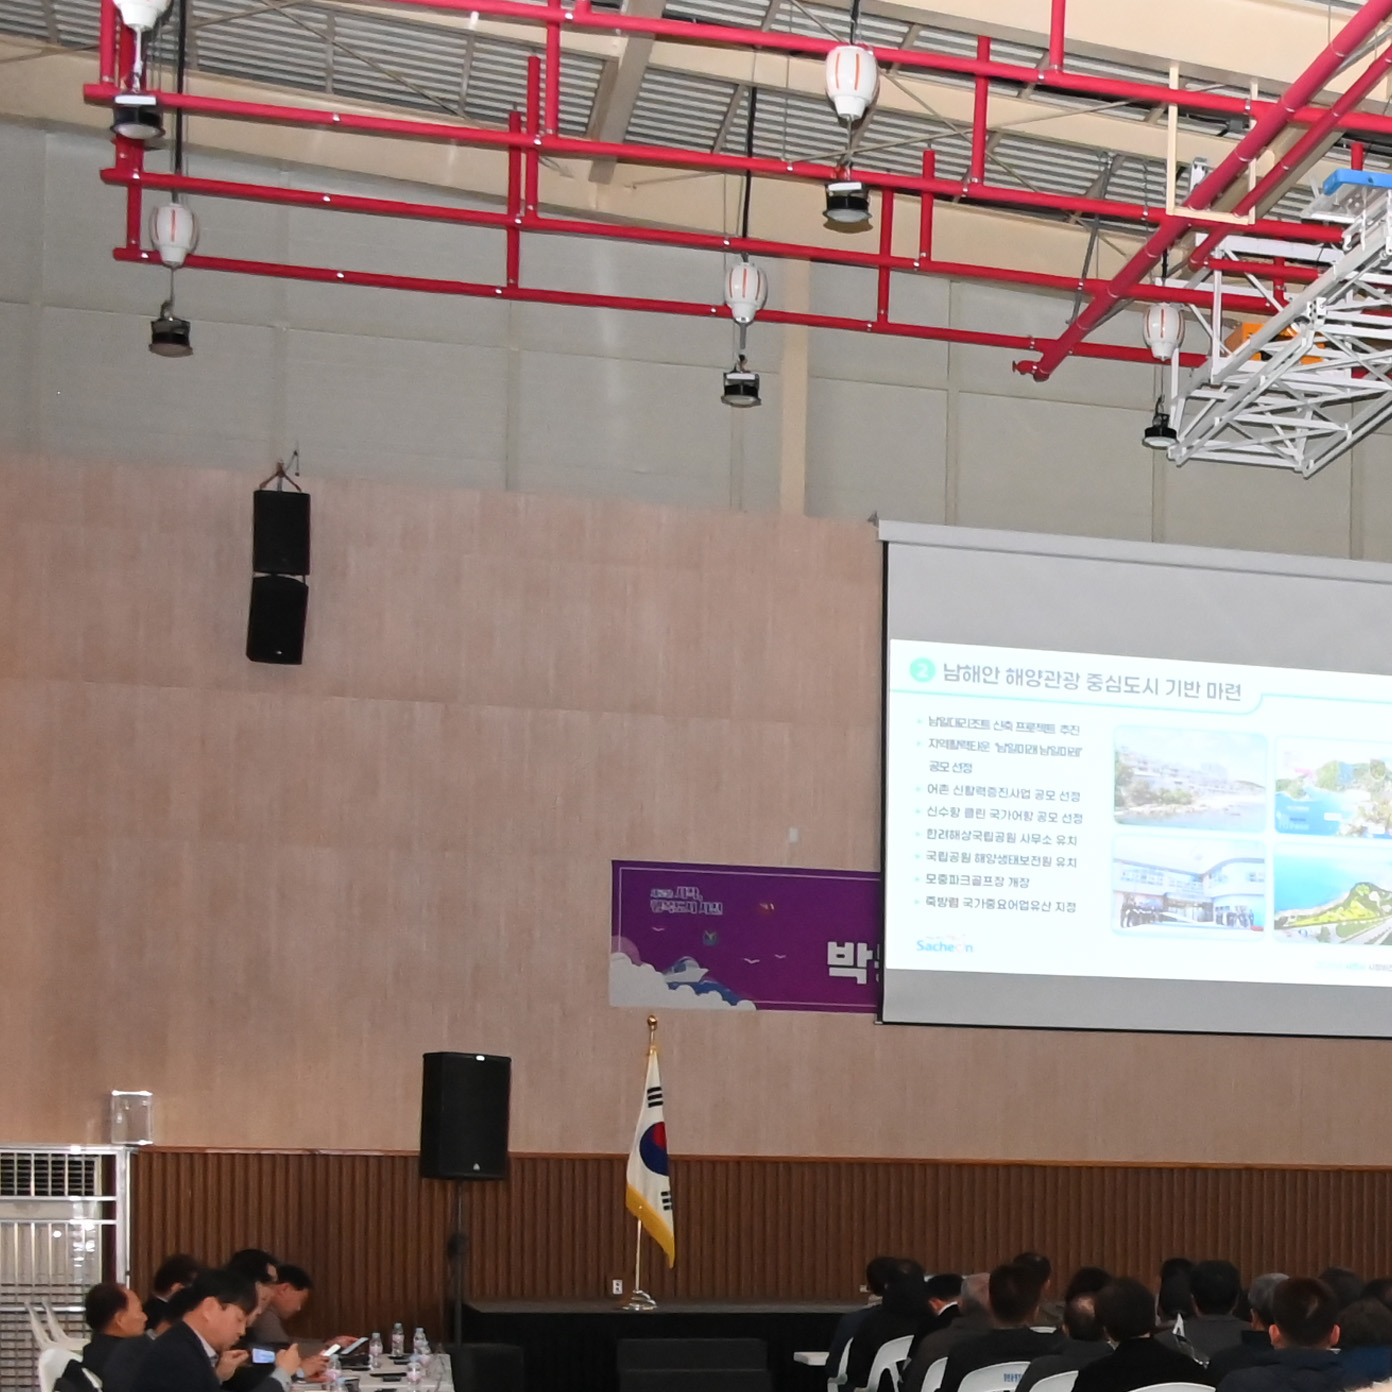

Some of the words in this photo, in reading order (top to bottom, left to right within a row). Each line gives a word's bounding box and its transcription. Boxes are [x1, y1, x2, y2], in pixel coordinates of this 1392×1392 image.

[943, 663, 1000, 684] 남해안
[1005, 667, 1080, 690] 해양관광
[1086, 673, 1159, 696] 중심도시
[1165, 679, 1201, 699] 기반
[1207, 682, 1241, 702] 마련
[1060, 724, 1080, 736] 추진
[929, 760, 950, 772] 공모
[952, 762, 973, 774] 선정
[927, 784, 950, 795] 어촌
[953, 785, 1031, 800] 신활력증진사업
[1034, 789, 1056, 801] 공모
[1059, 791, 1081, 803] 선정
[927, 806, 960, 818] 신수항
[990, 809, 1034, 822] 국가어항
[1037, 811, 1058, 823] 공모
[1062, 813, 1083, 825] 선정
[926, 828, 1016, 843] 한려해상국립공원
[1020, 833, 1052, 845] 사무소
[1056, 834, 1078, 846] 유치
[926, 850, 971, 864] 국립공원
[974, 852, 1052, 867] 해양생태보전원
[1056, 856, 1077, 868] 유치
[925, 873, 1004, 887] 모충파크골프장
[1008, 876, 1030, 888] 개장
[963, 897, 1052, 912] 국가중요어업유산
[1055, 901, 1077, 913] 지정
